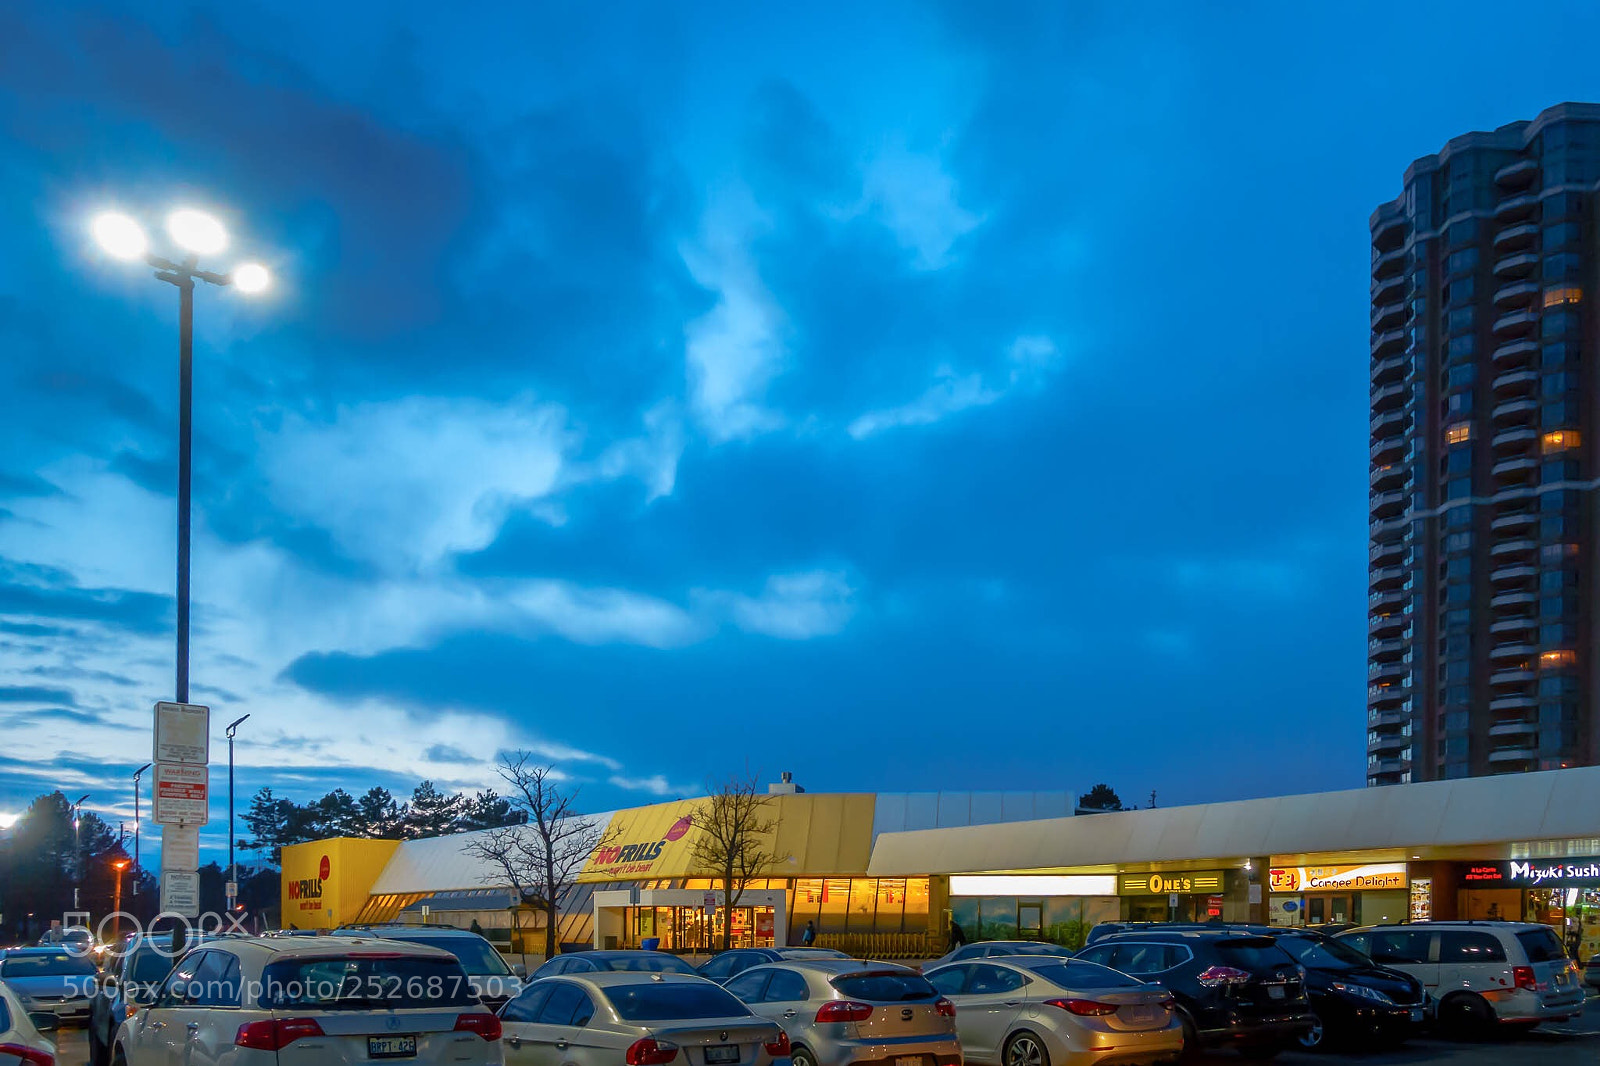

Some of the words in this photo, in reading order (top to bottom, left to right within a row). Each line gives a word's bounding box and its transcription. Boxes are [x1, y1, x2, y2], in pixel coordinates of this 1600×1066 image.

[164, 768, 200, 777] WARNING
[1510, 862, 1563, 884] Mizuki
[1566, 863, 1600, 877] Sush
[1356, 876, 1399, 888] Delight
